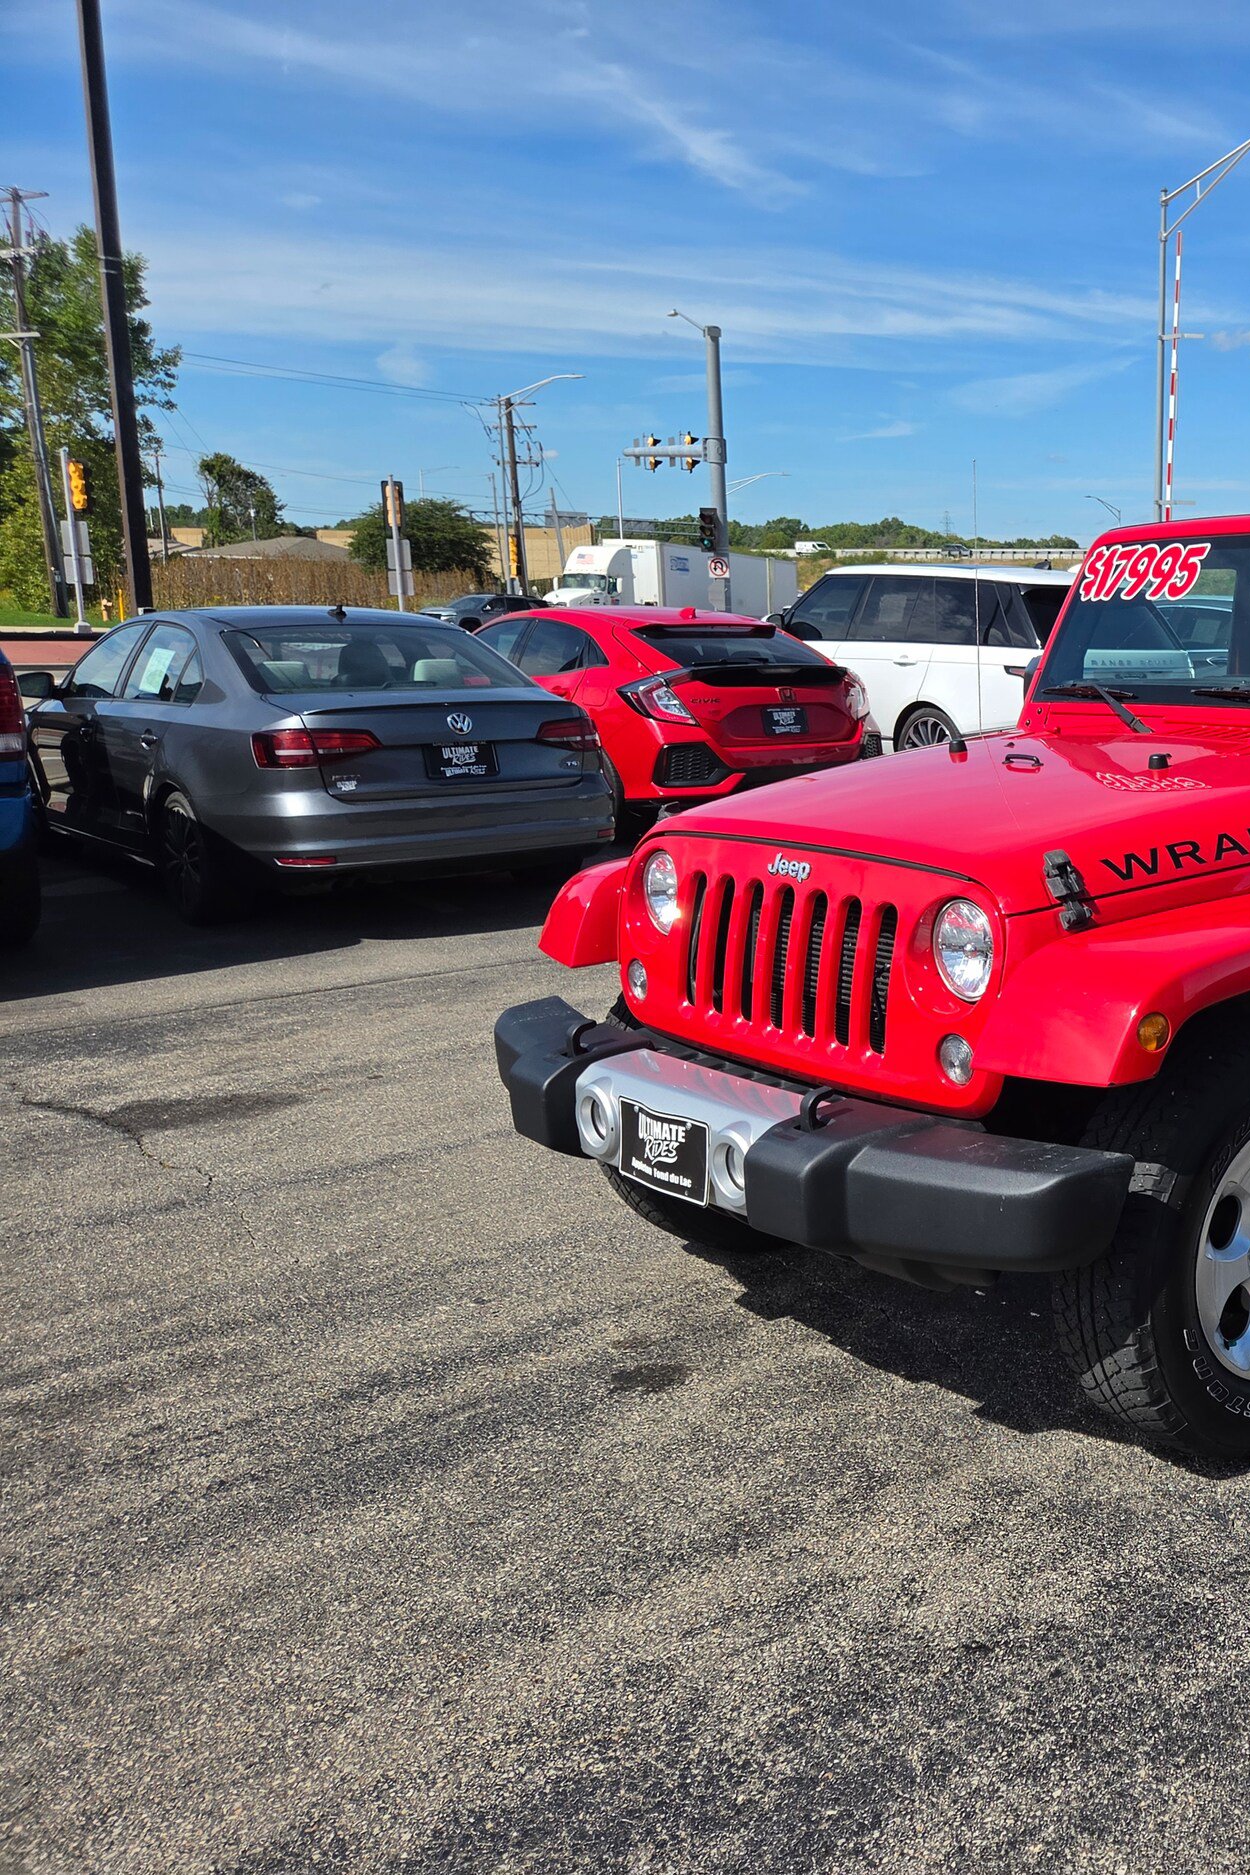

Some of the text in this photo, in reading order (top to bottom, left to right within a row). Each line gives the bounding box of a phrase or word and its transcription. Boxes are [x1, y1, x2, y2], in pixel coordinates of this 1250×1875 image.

[1080, 543, 1211, 601] $17995
[442, 746, 479, 759] ULTIMATE
[452, 753, 476, 765] RIDES
[767, 852, 812, 883] Jeep
[638, 1111, 686, 1143] ULTIMATE
[644, 1135, 680, 1165] RIDES
[653, 1167, 669, 1182] Fond
[669, 1172, 680, 1185] du
[679, 1175, 693, 1188] Lac
